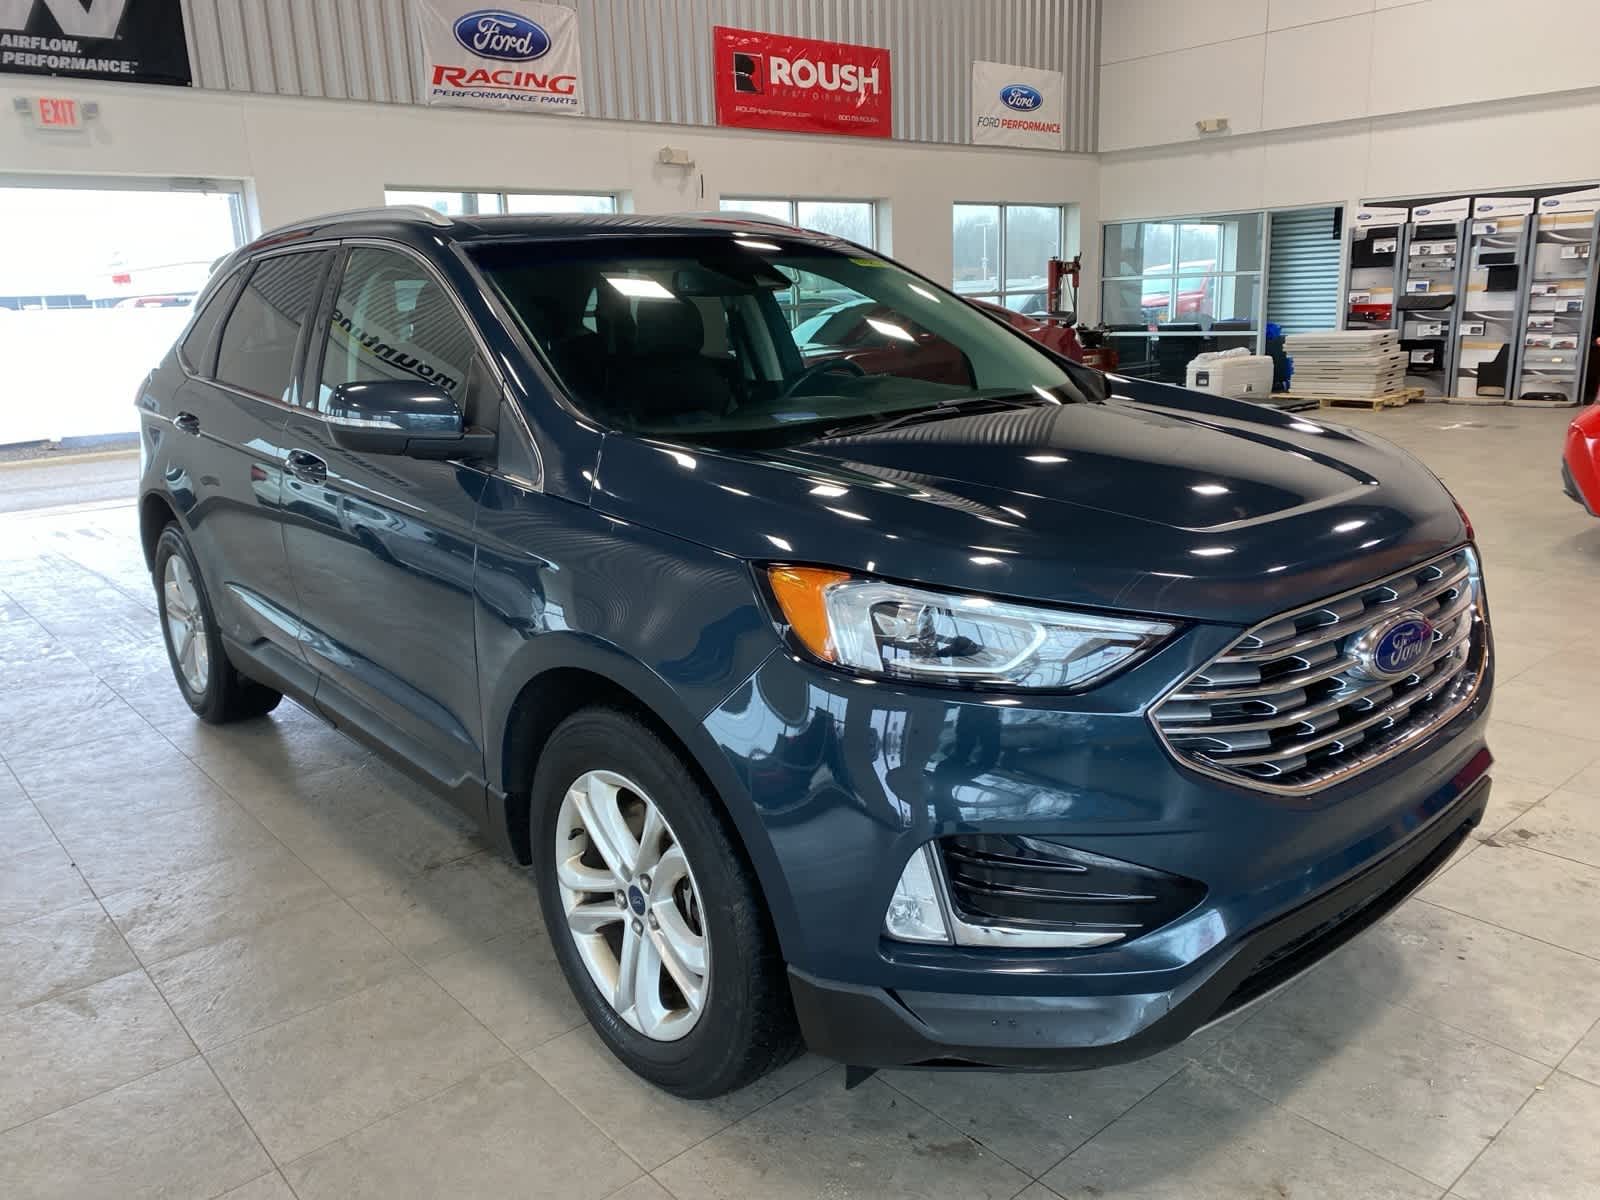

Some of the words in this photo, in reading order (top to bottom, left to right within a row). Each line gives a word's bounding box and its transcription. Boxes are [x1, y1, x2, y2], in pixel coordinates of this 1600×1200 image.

[0, 34, 82, 54] AIRFLOW.
[473, 17, 534, 55] Ford
[432, 64, 577, 96] RACING
[769, 55, 880, 95] ROUSH
[433, 87, 538, 103] PERFORMANCE
[540, 95, 579, 105] PARTS
[1007, 87, 1035, 108] Ford
[38, 97, 78, 126] EXIT
[977, 115, 1000, 129] FORD
[1000, 118, 1062, 134] PERFORMANCE
